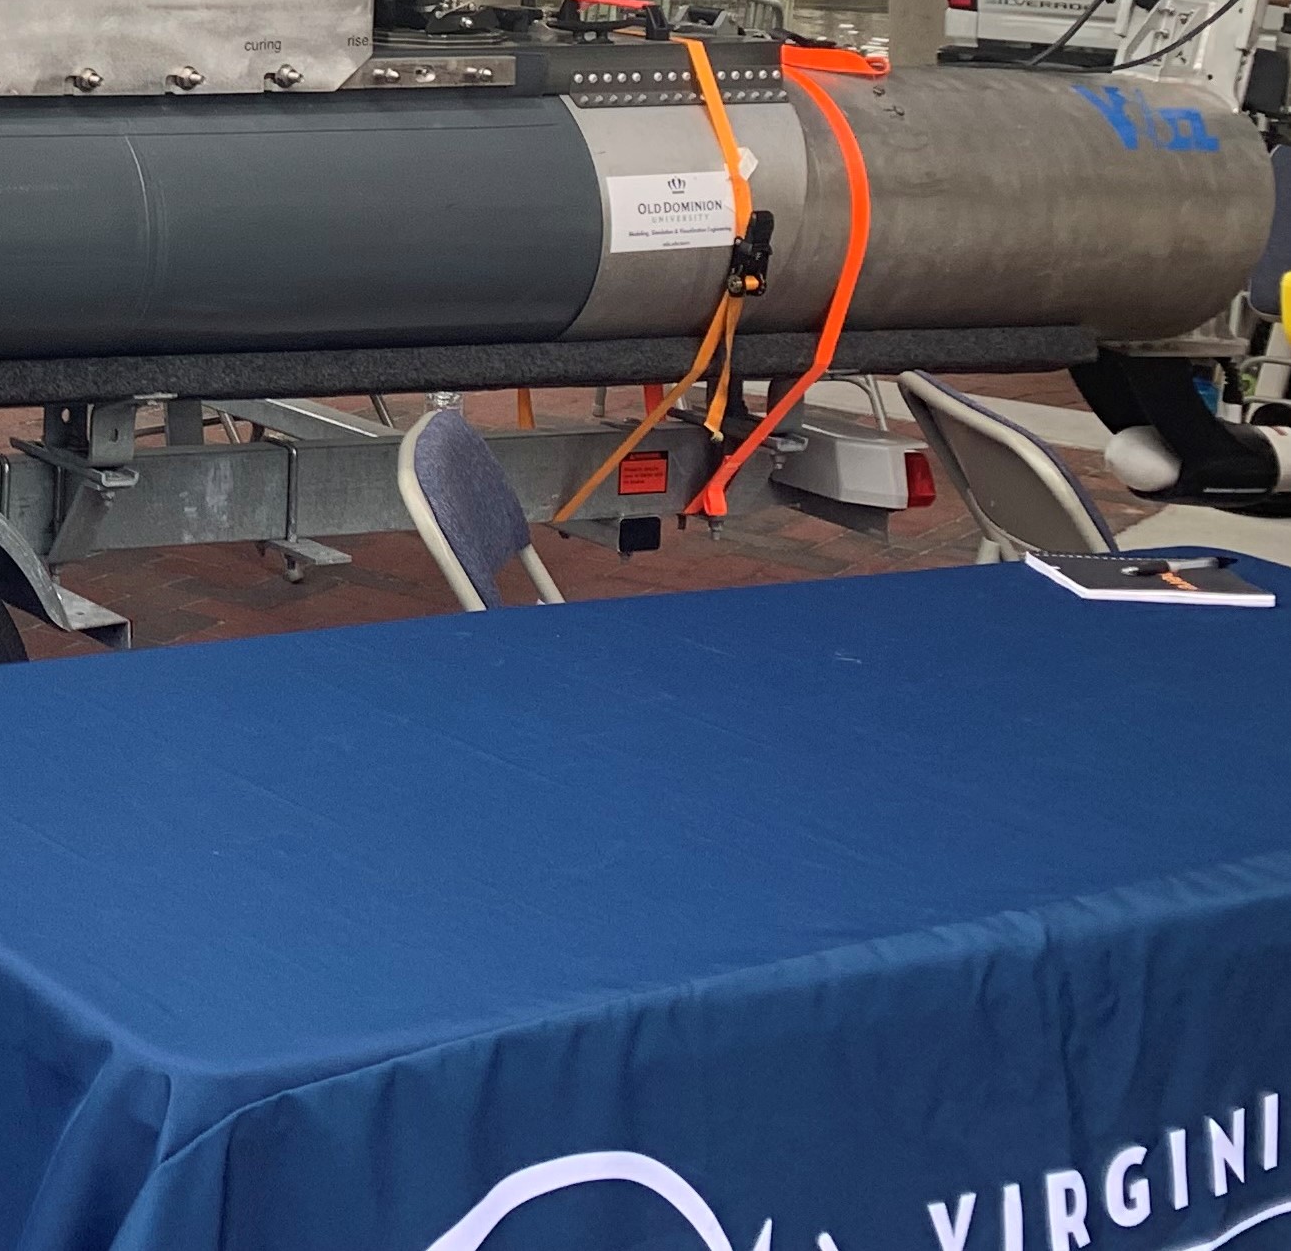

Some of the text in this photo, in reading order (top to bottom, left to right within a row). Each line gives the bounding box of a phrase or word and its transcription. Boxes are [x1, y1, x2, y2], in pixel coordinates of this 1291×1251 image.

[244, 38, 282, 53] curing
[637, 200, 723, 215] OLD DOMINION
[651, 213, 710, 224] UNIVERSITY
[927, 1093, 1279, 1251] VIRGINI
